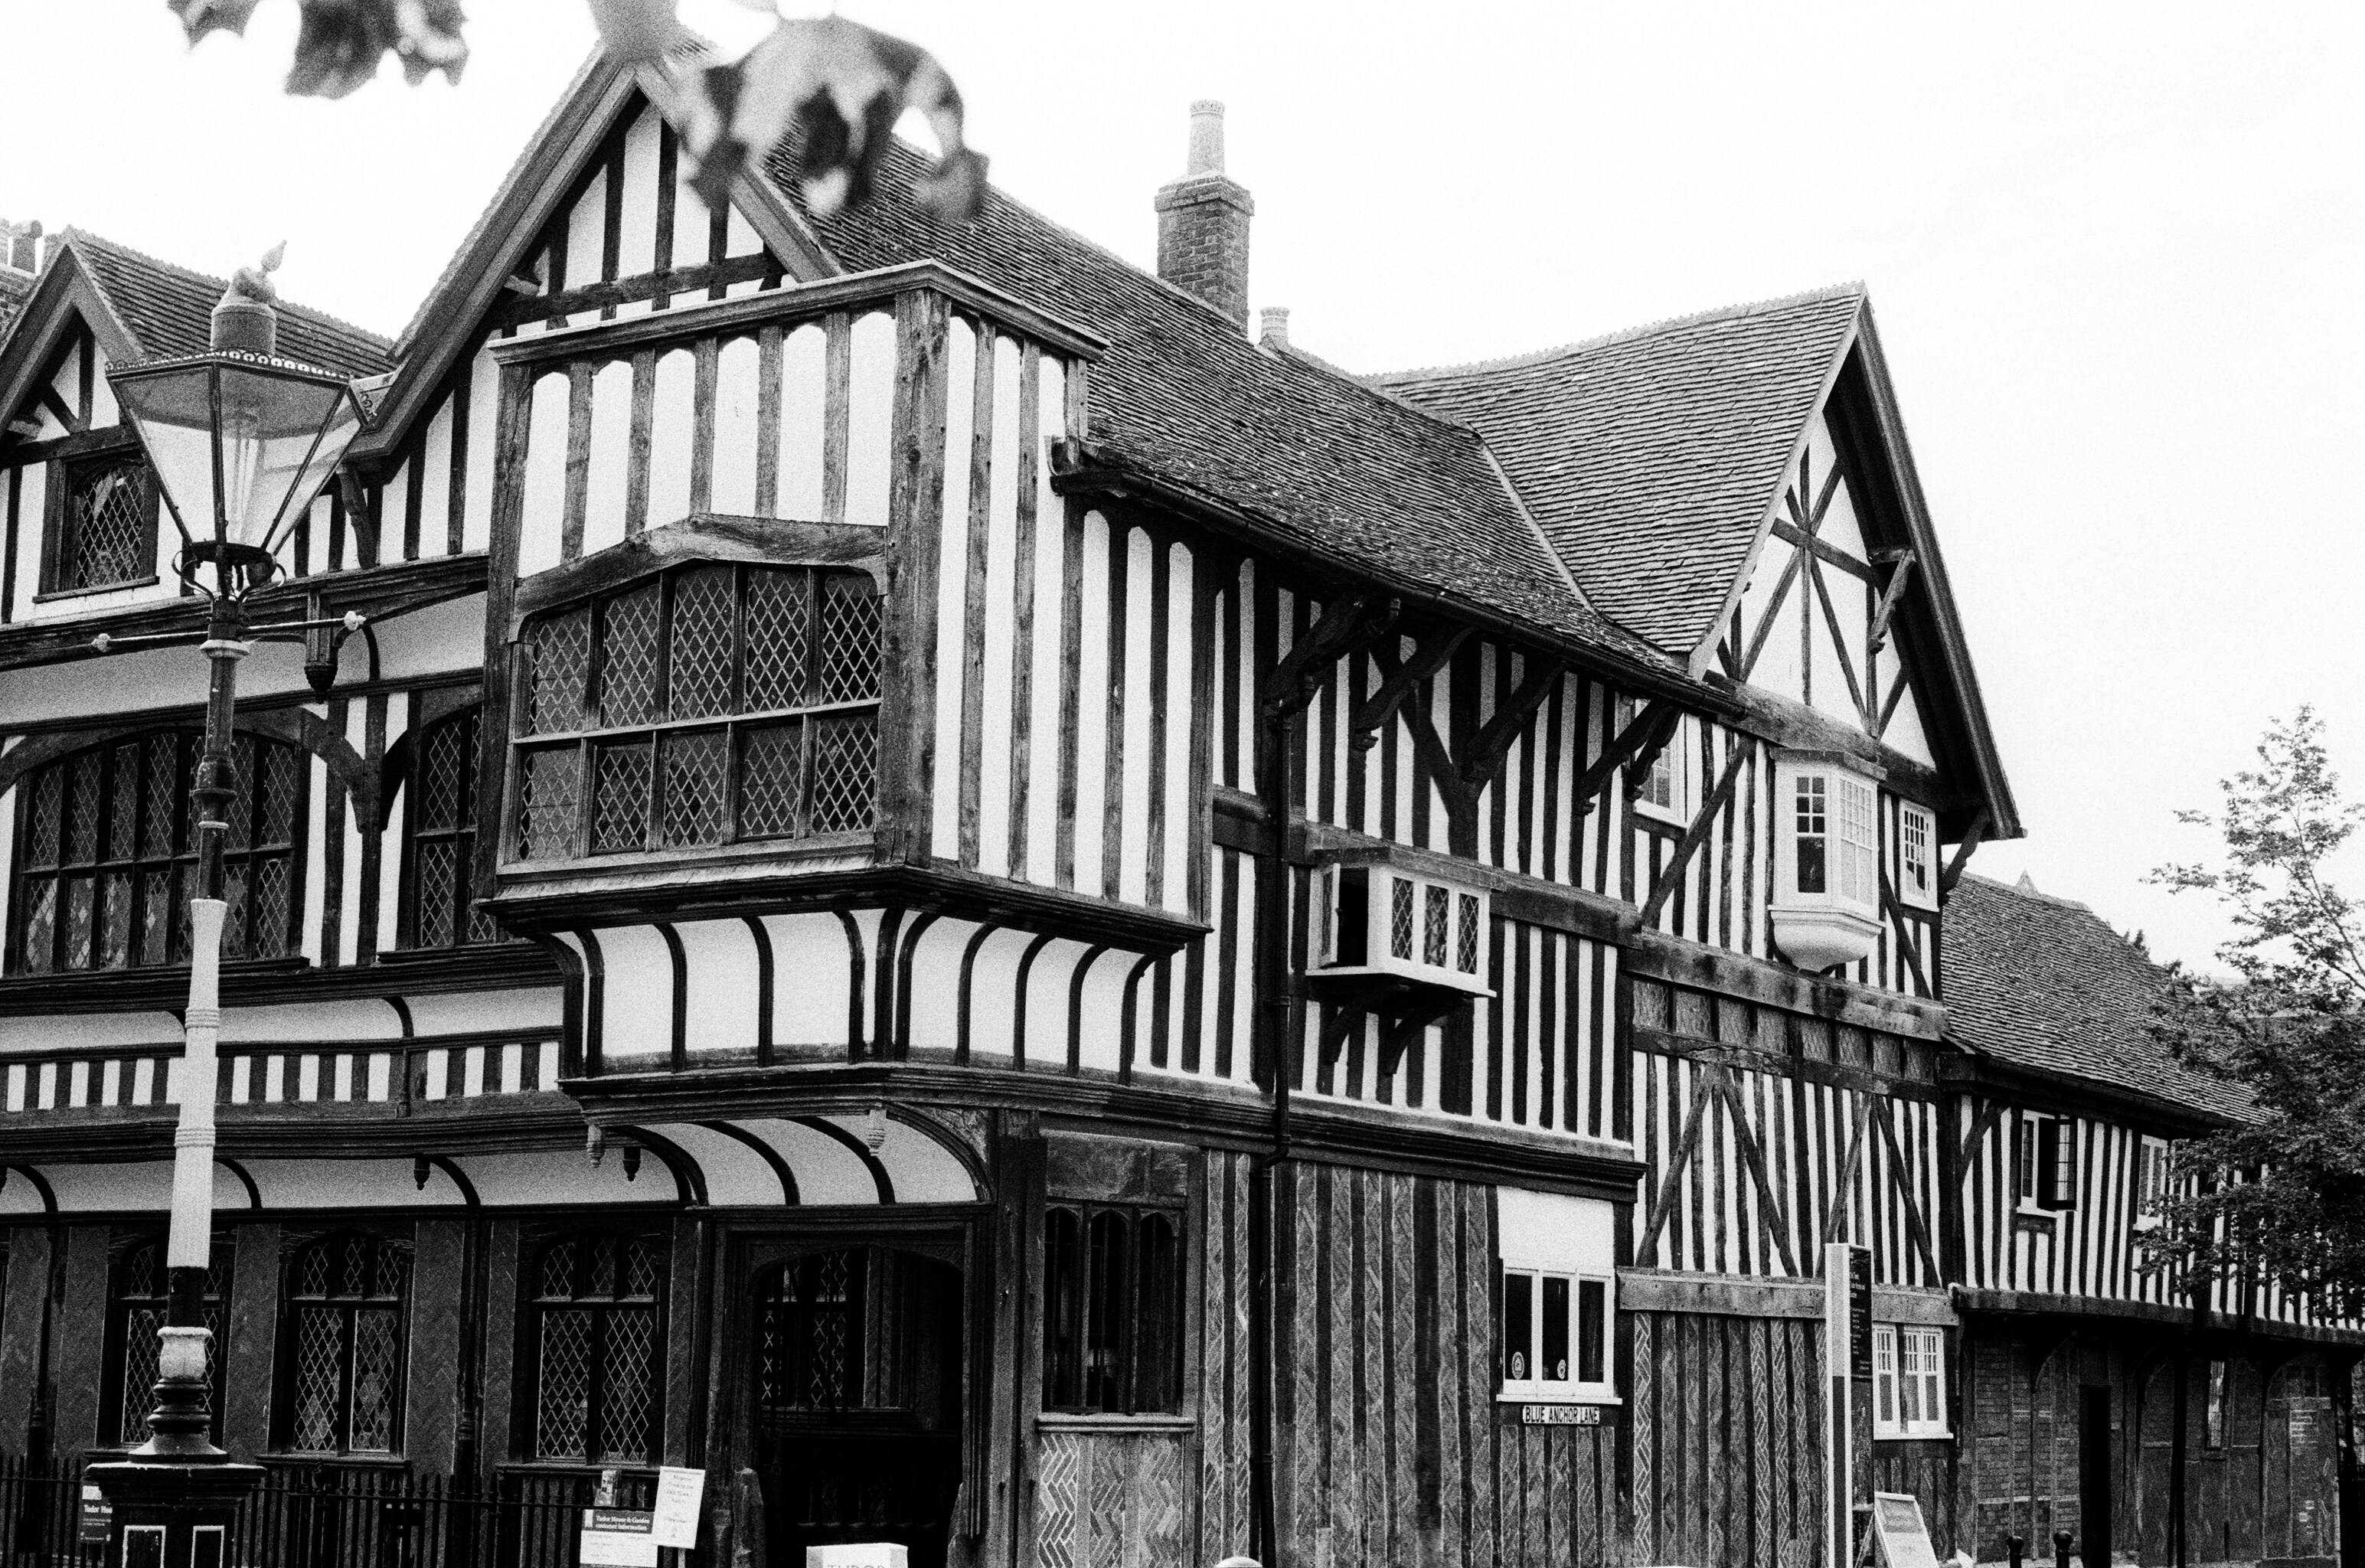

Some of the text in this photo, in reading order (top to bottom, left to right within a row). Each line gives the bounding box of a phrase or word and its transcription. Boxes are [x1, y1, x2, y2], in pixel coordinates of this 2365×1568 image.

[1525, 1406, 1599, 1423] BLUE ANCHOR LANE
[84, 1504, 100, 1513] Tudor
